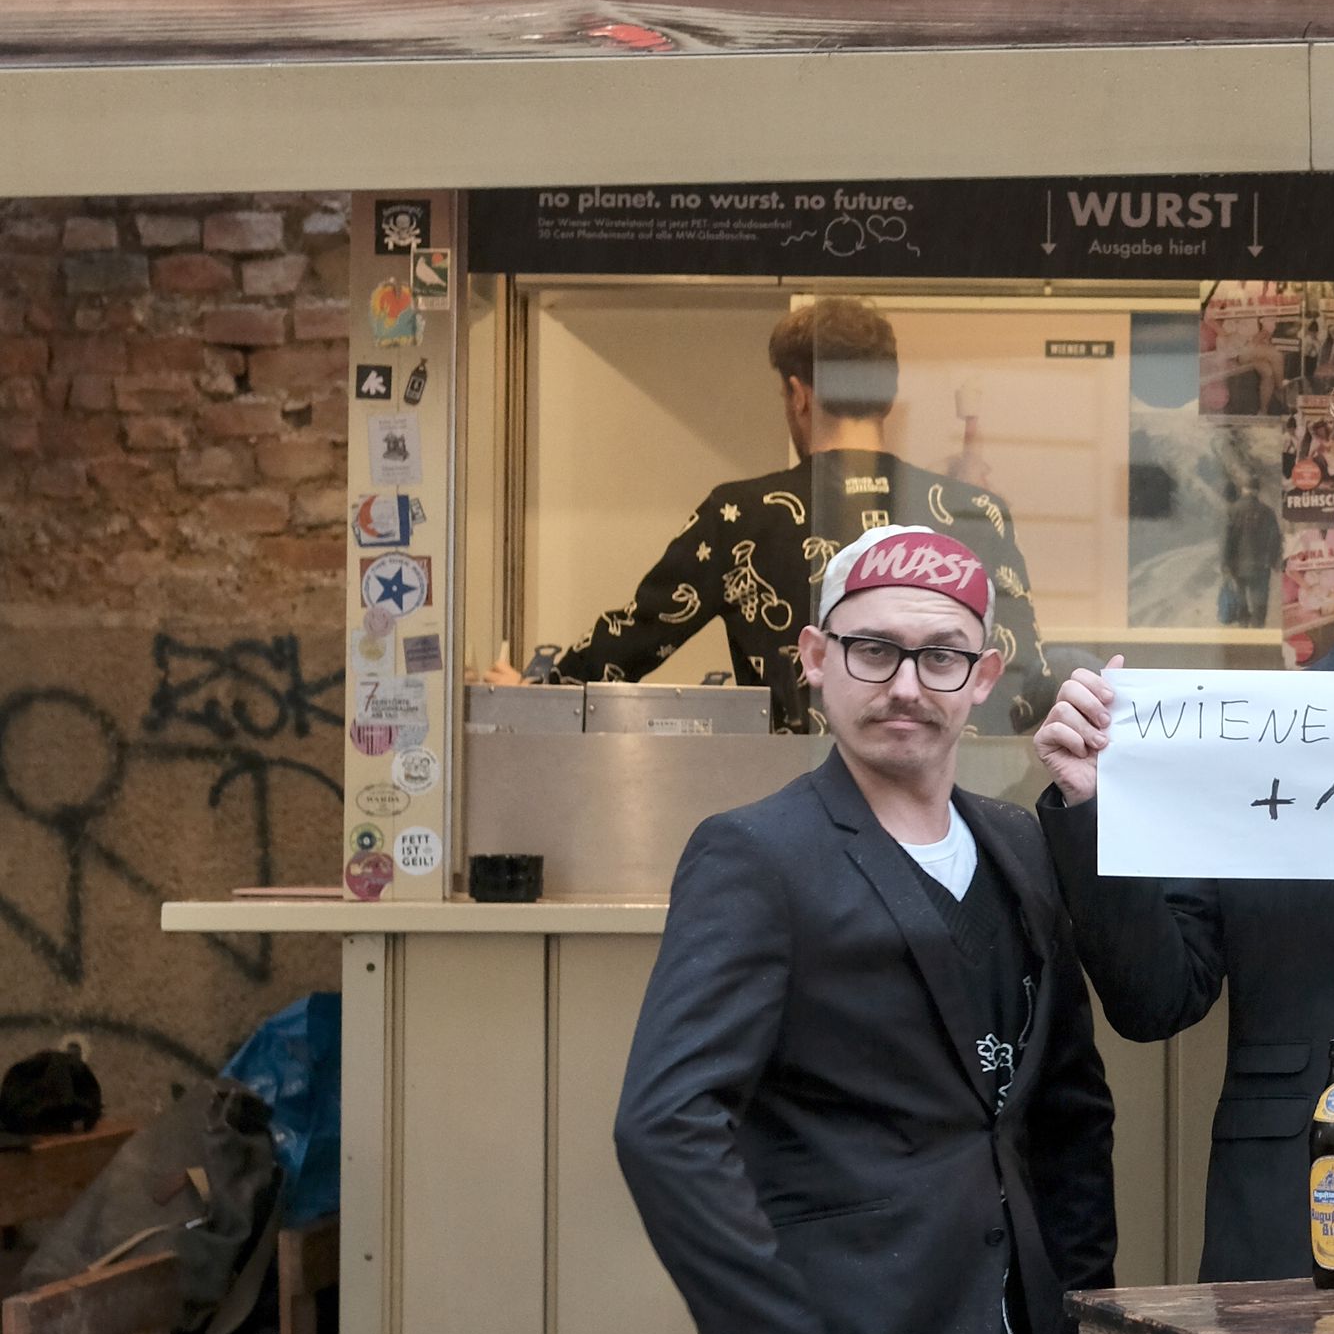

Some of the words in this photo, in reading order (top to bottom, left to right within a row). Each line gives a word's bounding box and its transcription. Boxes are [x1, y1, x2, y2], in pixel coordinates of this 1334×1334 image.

[539, 192, 569, 208] no
[578, 186, 660, 214] planet.
[670, 192, 701, 208] no
[709, 191, 785, 209] wurst.
[794, 193, 825, 210] no
[833, 188, 914, 211] future.
[1067, 190, 1239, 228] WURST
[1088, 239, 1163, 259] Ausgabe
[1168, 238, 1207, 255] hier!
[860, 540, 982, 592] WURST
[402, 834, 430, 844] FETT
[402, 847, 419, 855] IST
[402, 857, 434, 867] GEIL!
